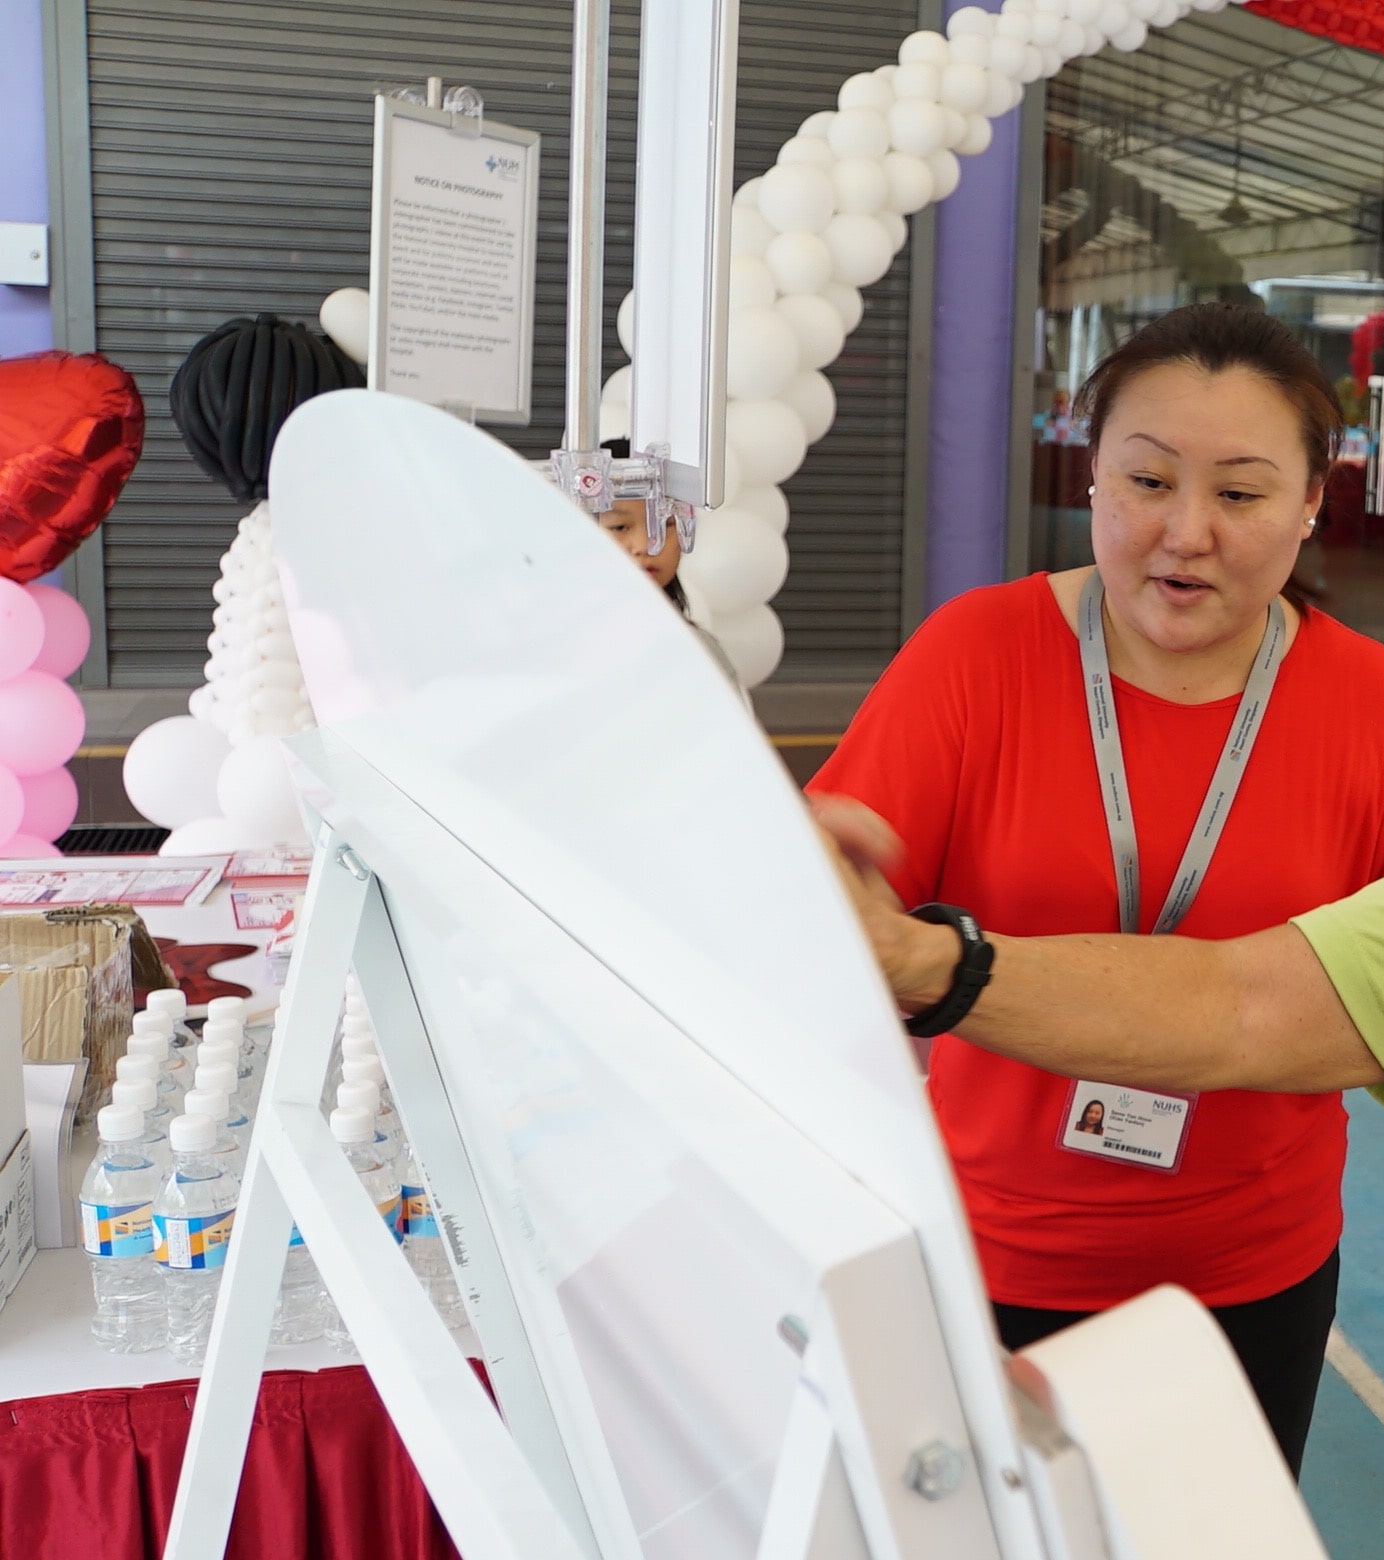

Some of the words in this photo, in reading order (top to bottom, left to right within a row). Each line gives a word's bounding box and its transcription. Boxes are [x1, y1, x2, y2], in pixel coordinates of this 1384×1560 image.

[414, 175, 440, 189] NOTICE
[454, 184, 504, 201] PHOTOGRAPHY
[1153, 1099, 1182, 1114] NUHS
